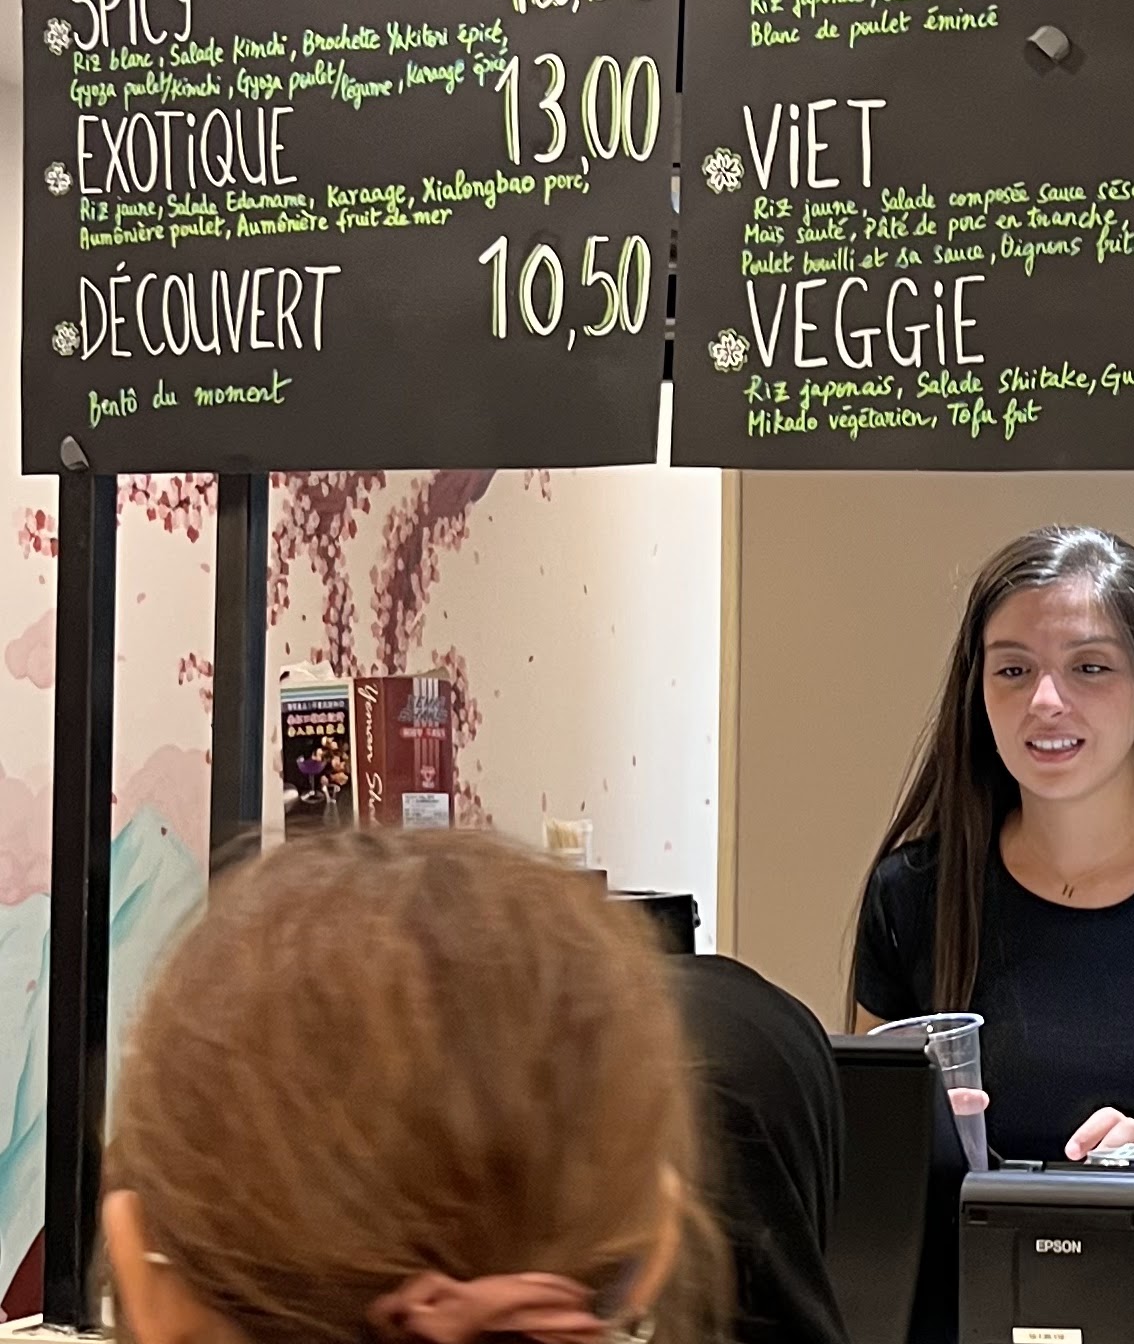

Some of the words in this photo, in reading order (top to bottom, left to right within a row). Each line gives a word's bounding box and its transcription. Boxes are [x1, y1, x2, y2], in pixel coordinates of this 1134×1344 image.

[751, 22, 800, 48] Blanc
[815, 18, 840, 41] de
[851, 9, 912, 48] poulet
[73, 51, 102, 74] Riz
[170, 37, 224, 67] Salade
[495, 52, 661, 174] 13,00
[80, 196, 109, 221] Riz
[336, 207, 382, 233] fruit
[413, 207, 453, 226] mer
[754, 196, 793, 220] Riz
[881, 183, 936, 212] Salade
[912, 212, 937, 236] de
[949, 215, 986, 241] porc
[994, 213, 1023, 229] en
[858, 246, 889, 269] et
[80, 261, 342, 361] DÉCOUVERT
[478, 234, 652, 351] 10,50
[152, 380, 178, 409] du
[194, 369, 293, 408] moment
[743, 374, 790, 403] Riz
[916, 368, 984, 399] Salade
[748, 408, 818, 437] Mikado
[947, 396, 997, 438] Tofu
[1035, 1238, 1082, 1254] EPSON
